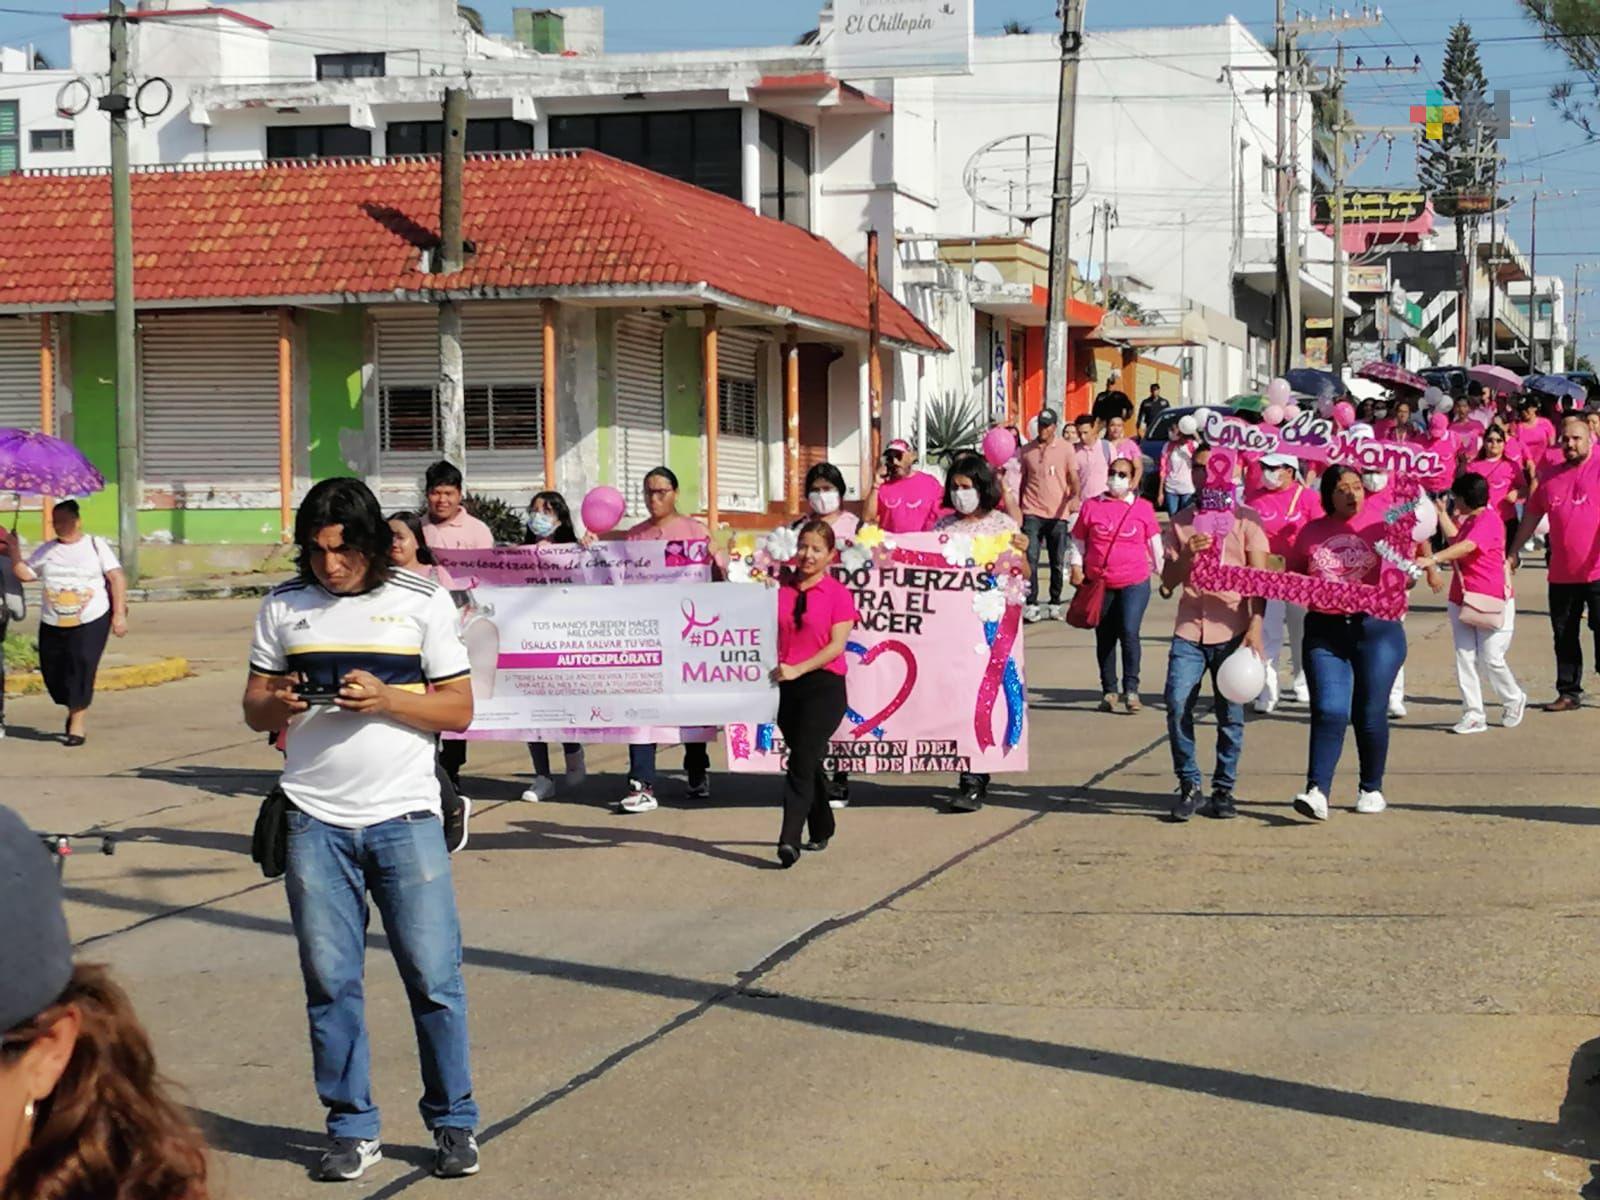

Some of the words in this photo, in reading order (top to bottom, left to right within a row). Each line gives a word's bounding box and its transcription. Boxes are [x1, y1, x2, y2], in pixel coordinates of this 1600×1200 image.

[845, 14, 865, 34] El
[1327, 431, 1446, 477] Mama
[880, 569, 990, 592] FUERZAS
[906, 592, 936, 613] EL
[552, 620, 588, 630] MANOS
[628, 618, 660, 629] HACER
[559, 640, 585, 650] PARA
[586, 640, 623, 650] SALVAR
[625, 639, 638, 649] TU
[640, 638, 663, 649] VIDA
[689, 628, 761, 647] #DATE
[720, 649, 761, 662] una
[682, 662, 761, 684] MANO
[917, 740, 956, 757] DEL
[876, 756, 902, 772] DE
[910, 756, 970, 773] MAMA
